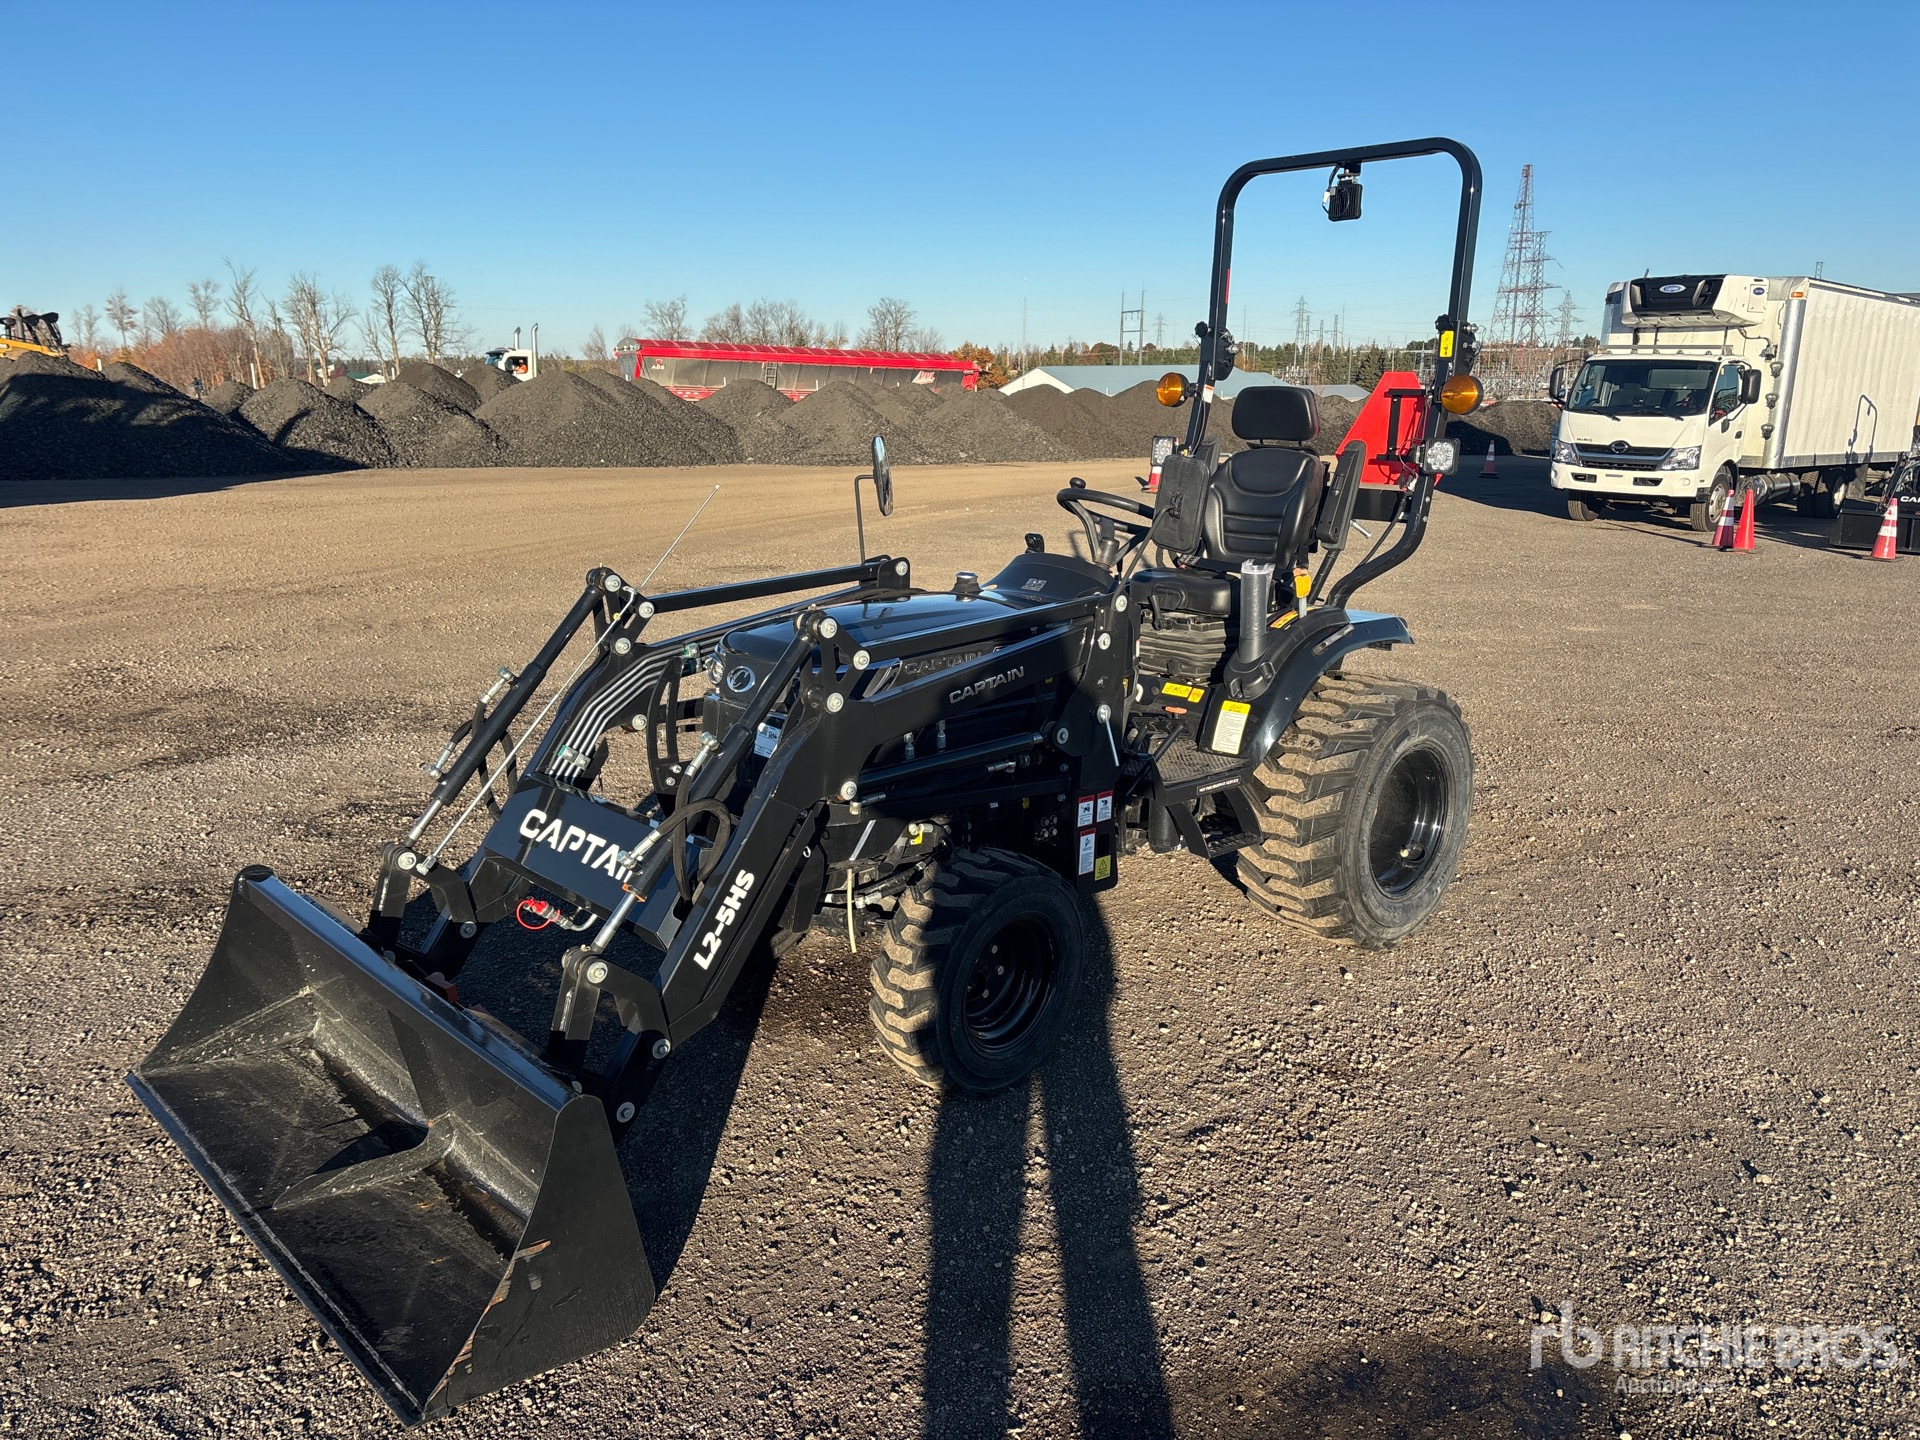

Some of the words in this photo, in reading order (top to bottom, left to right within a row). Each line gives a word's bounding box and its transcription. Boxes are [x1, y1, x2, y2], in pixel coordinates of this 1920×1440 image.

[948, 665, 1025, 704] CAPTAIN
[519, 808, 643, 883] CAPTAI
[693, 869, 755, 971] L2-5HS
